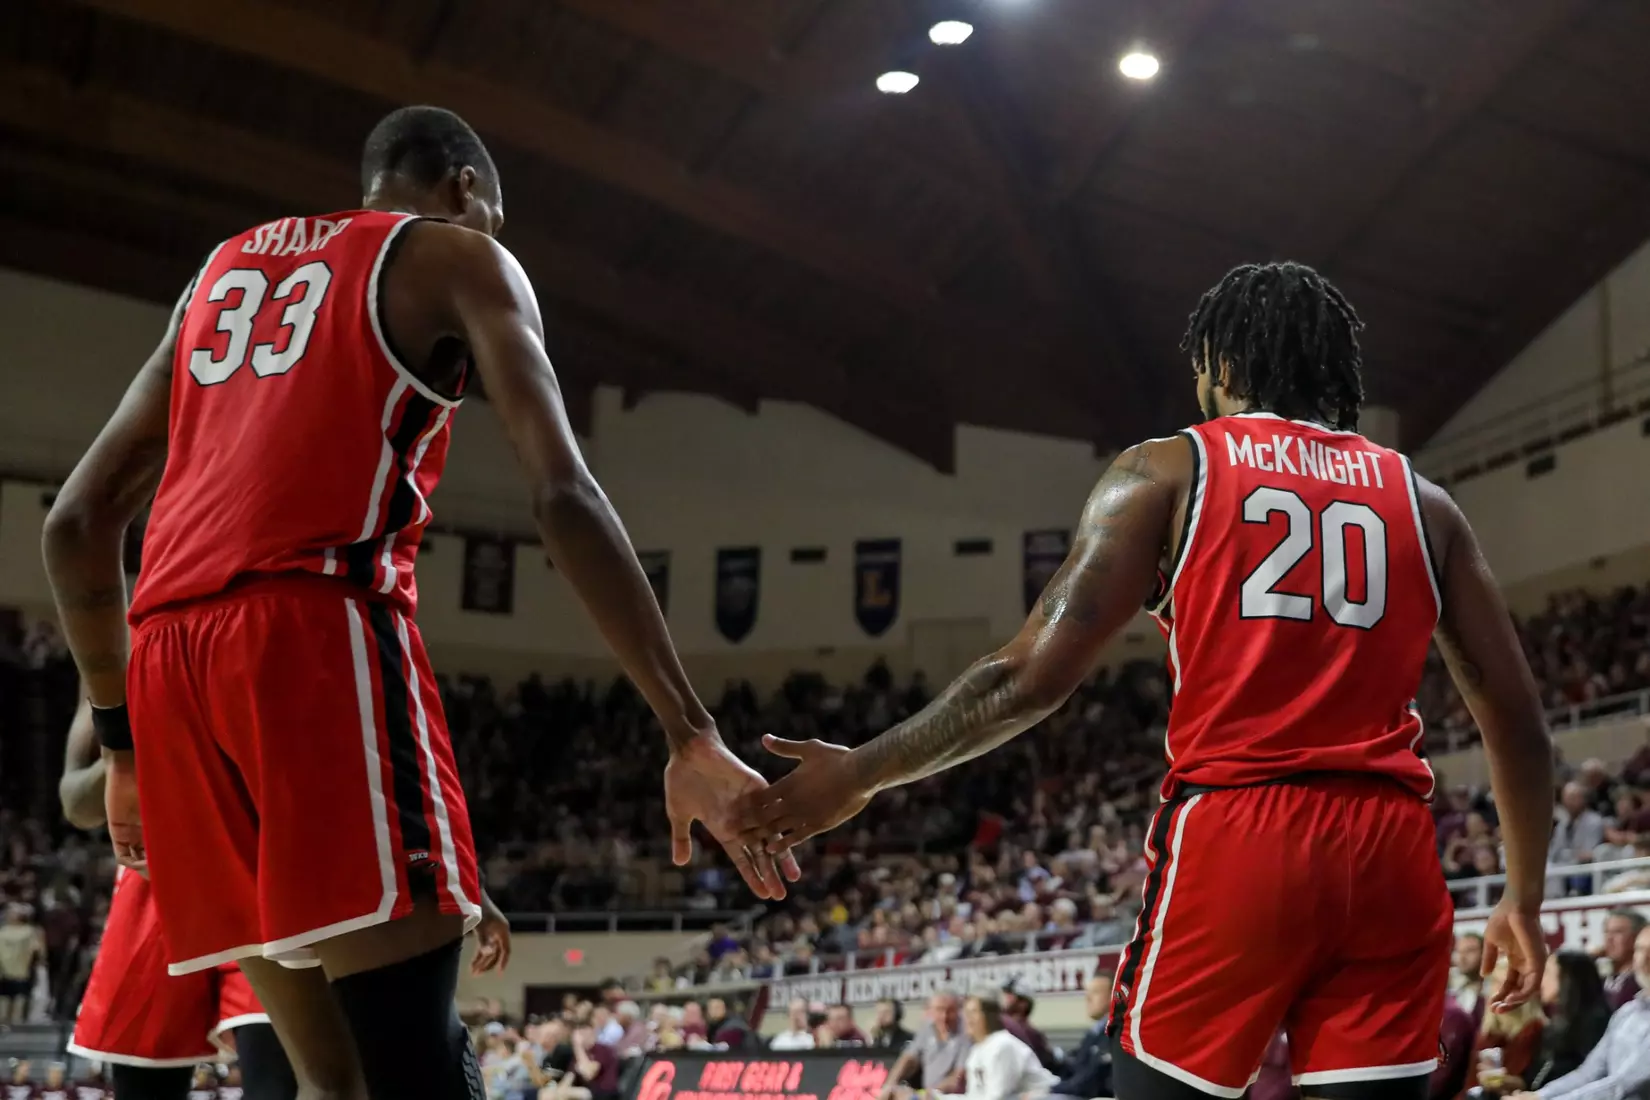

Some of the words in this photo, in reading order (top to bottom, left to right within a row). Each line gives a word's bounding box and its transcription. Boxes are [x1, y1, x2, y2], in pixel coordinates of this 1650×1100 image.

[242, 216, 354, 256] SHARP
[188, 260, 333, 387] 33
[1224, 431, 1384, 489] McKNIGHT
[1239, 485, 1388, 631] 20
